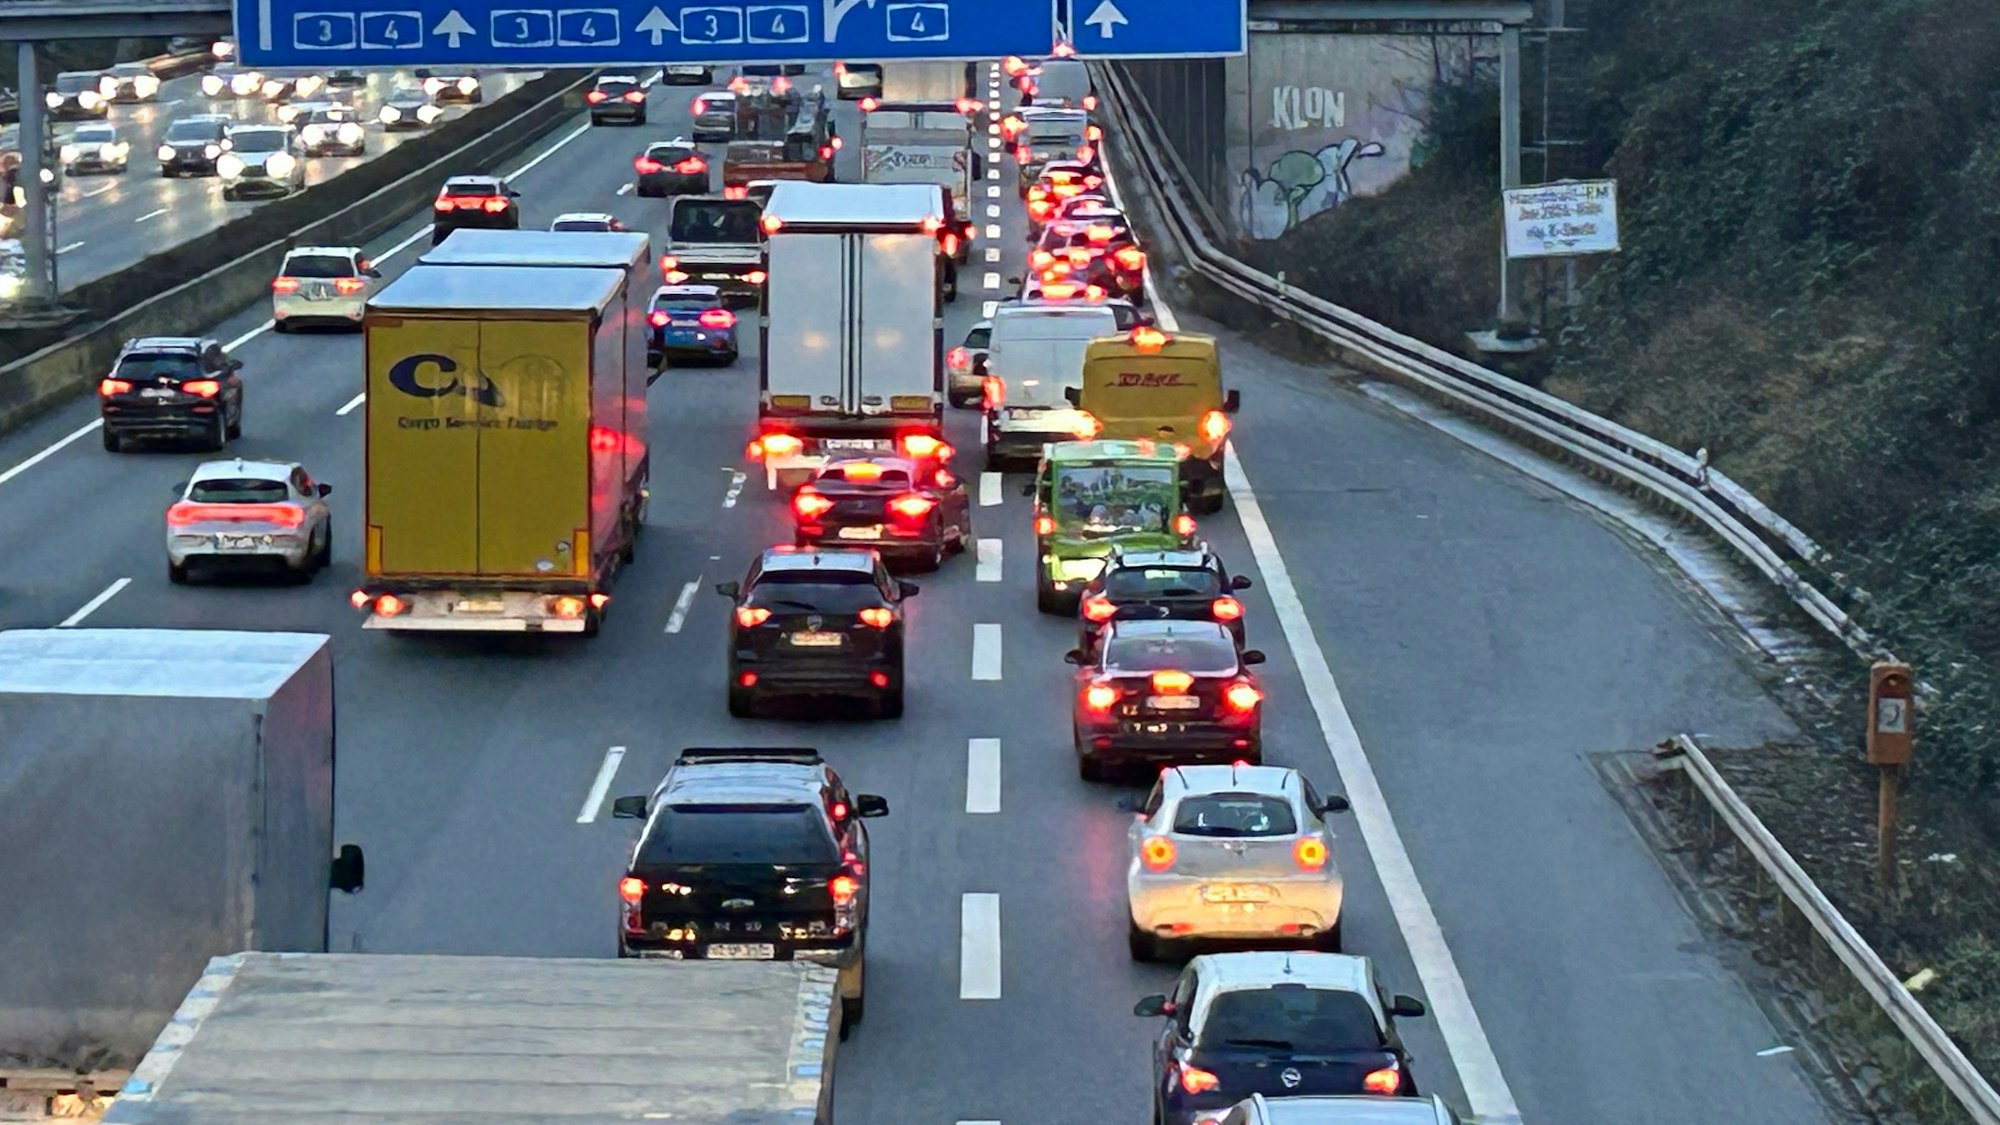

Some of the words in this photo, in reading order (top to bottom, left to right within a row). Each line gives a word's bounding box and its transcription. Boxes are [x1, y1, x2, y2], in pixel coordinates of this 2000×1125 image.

[318, 20, 332, 42] 3
[384, 20, 399, 40] 4
[514, 17, 529, 39] 3
[581, 18, 596, 38] 4
[704, 14, 718, 37] 3
[770, 14, 786, 34] 4
[910, 11, 926, 32] 4
[1273, 84, 1345, 130] KLON
